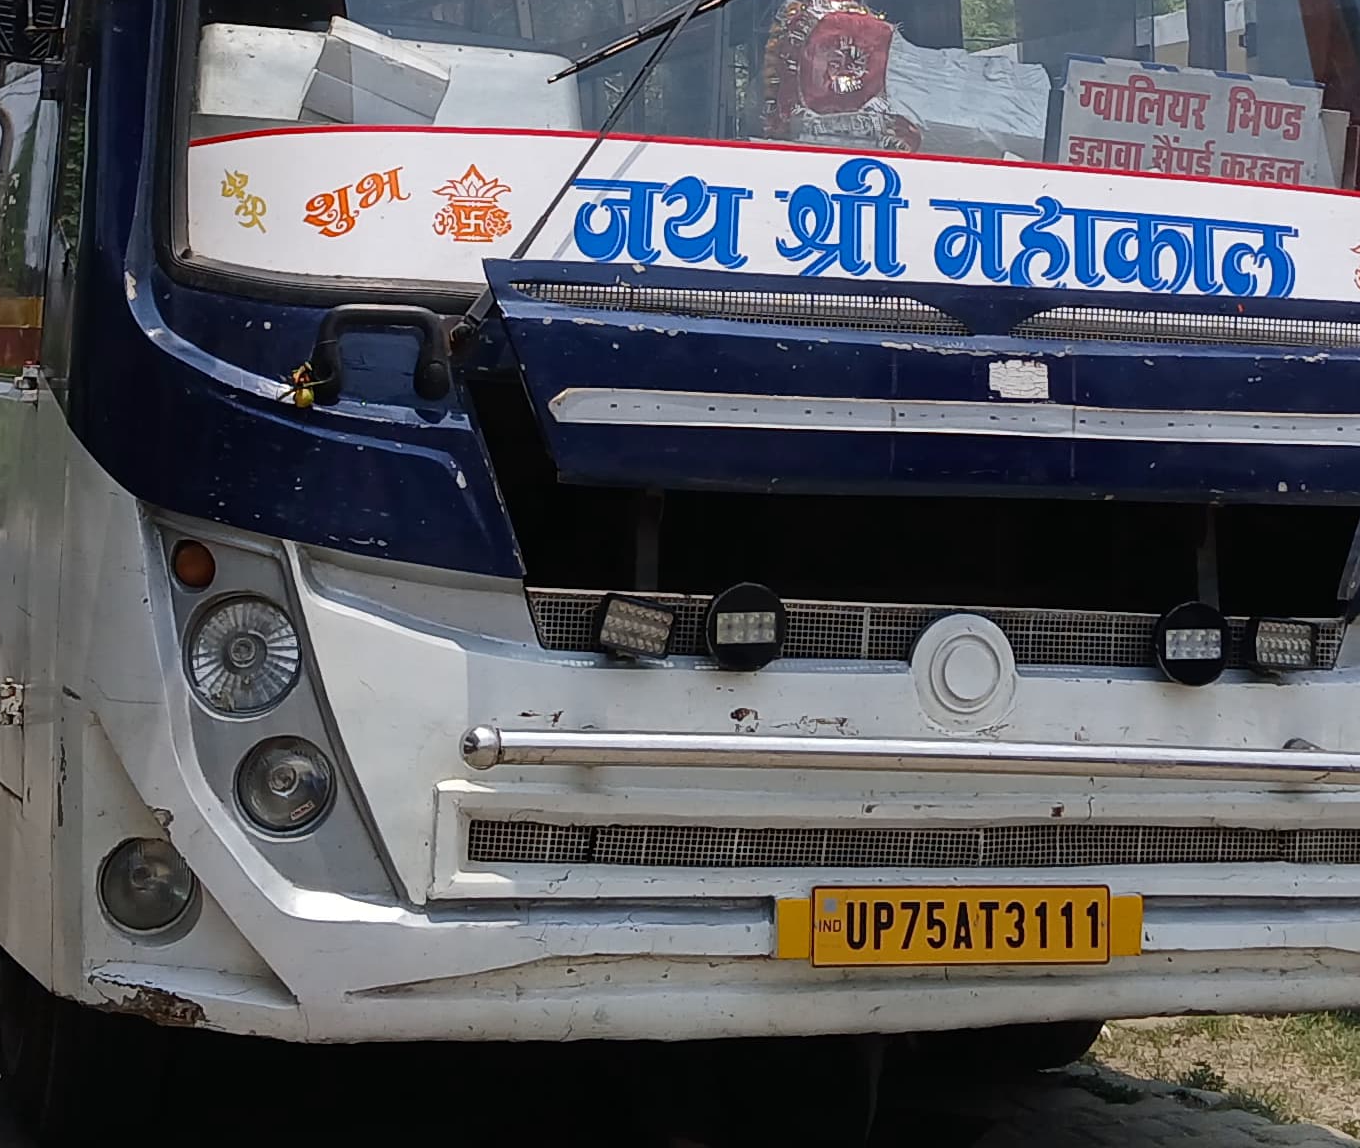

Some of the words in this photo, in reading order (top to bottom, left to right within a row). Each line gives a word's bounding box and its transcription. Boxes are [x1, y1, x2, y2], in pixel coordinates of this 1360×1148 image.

[1079, 74, 1211, 131] ग्वालियर
[1227, 86, 1306, 141] भिण्ड
[303, 166, 412, 237] शुभ
[1220, 152, 1305, 186] करहल
[572, 176, 754, 270] जय
[775, 157, 909, 278] श्री
[929, 196, 1300, 299] महाकाल
[817, 919, 841, 933] IND
[846, 900, 1100, 951] UP75AT3111
